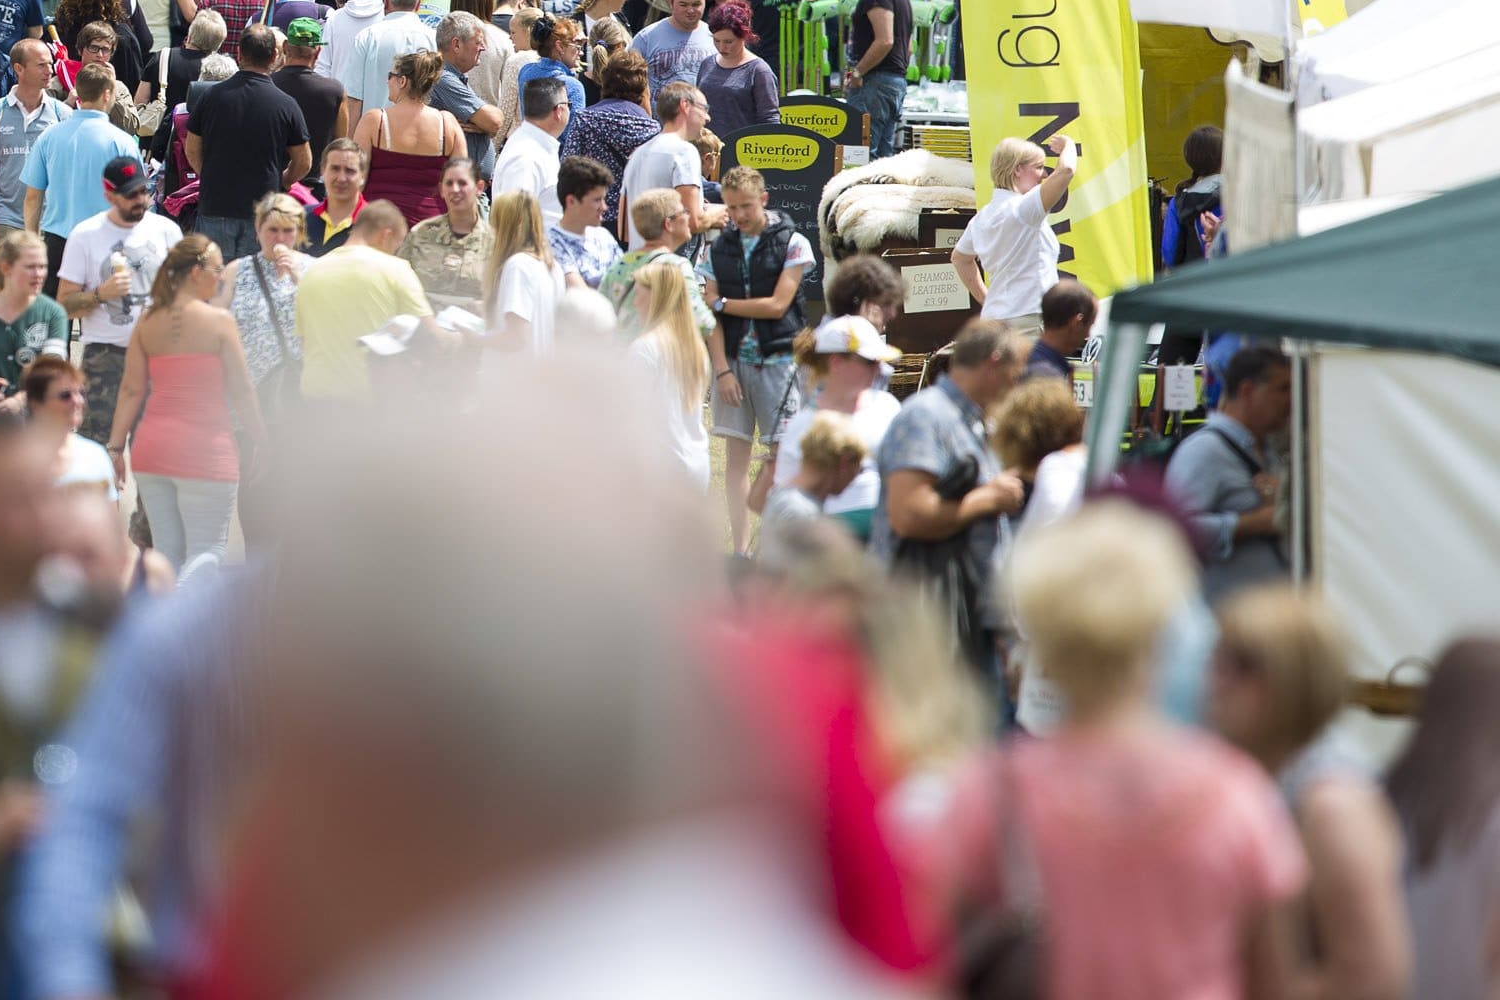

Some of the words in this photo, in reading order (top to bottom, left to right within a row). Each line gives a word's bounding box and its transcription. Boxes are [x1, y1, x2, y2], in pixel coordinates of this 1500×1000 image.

[743, 142, 810, 157] Riverford
[750, 156, 778, 164] organic
[913, 271, 955, 283] CHAMOIS
[912, 283, 959, 296] LEATHERS
[925, 296, 949, 306] £3.99
